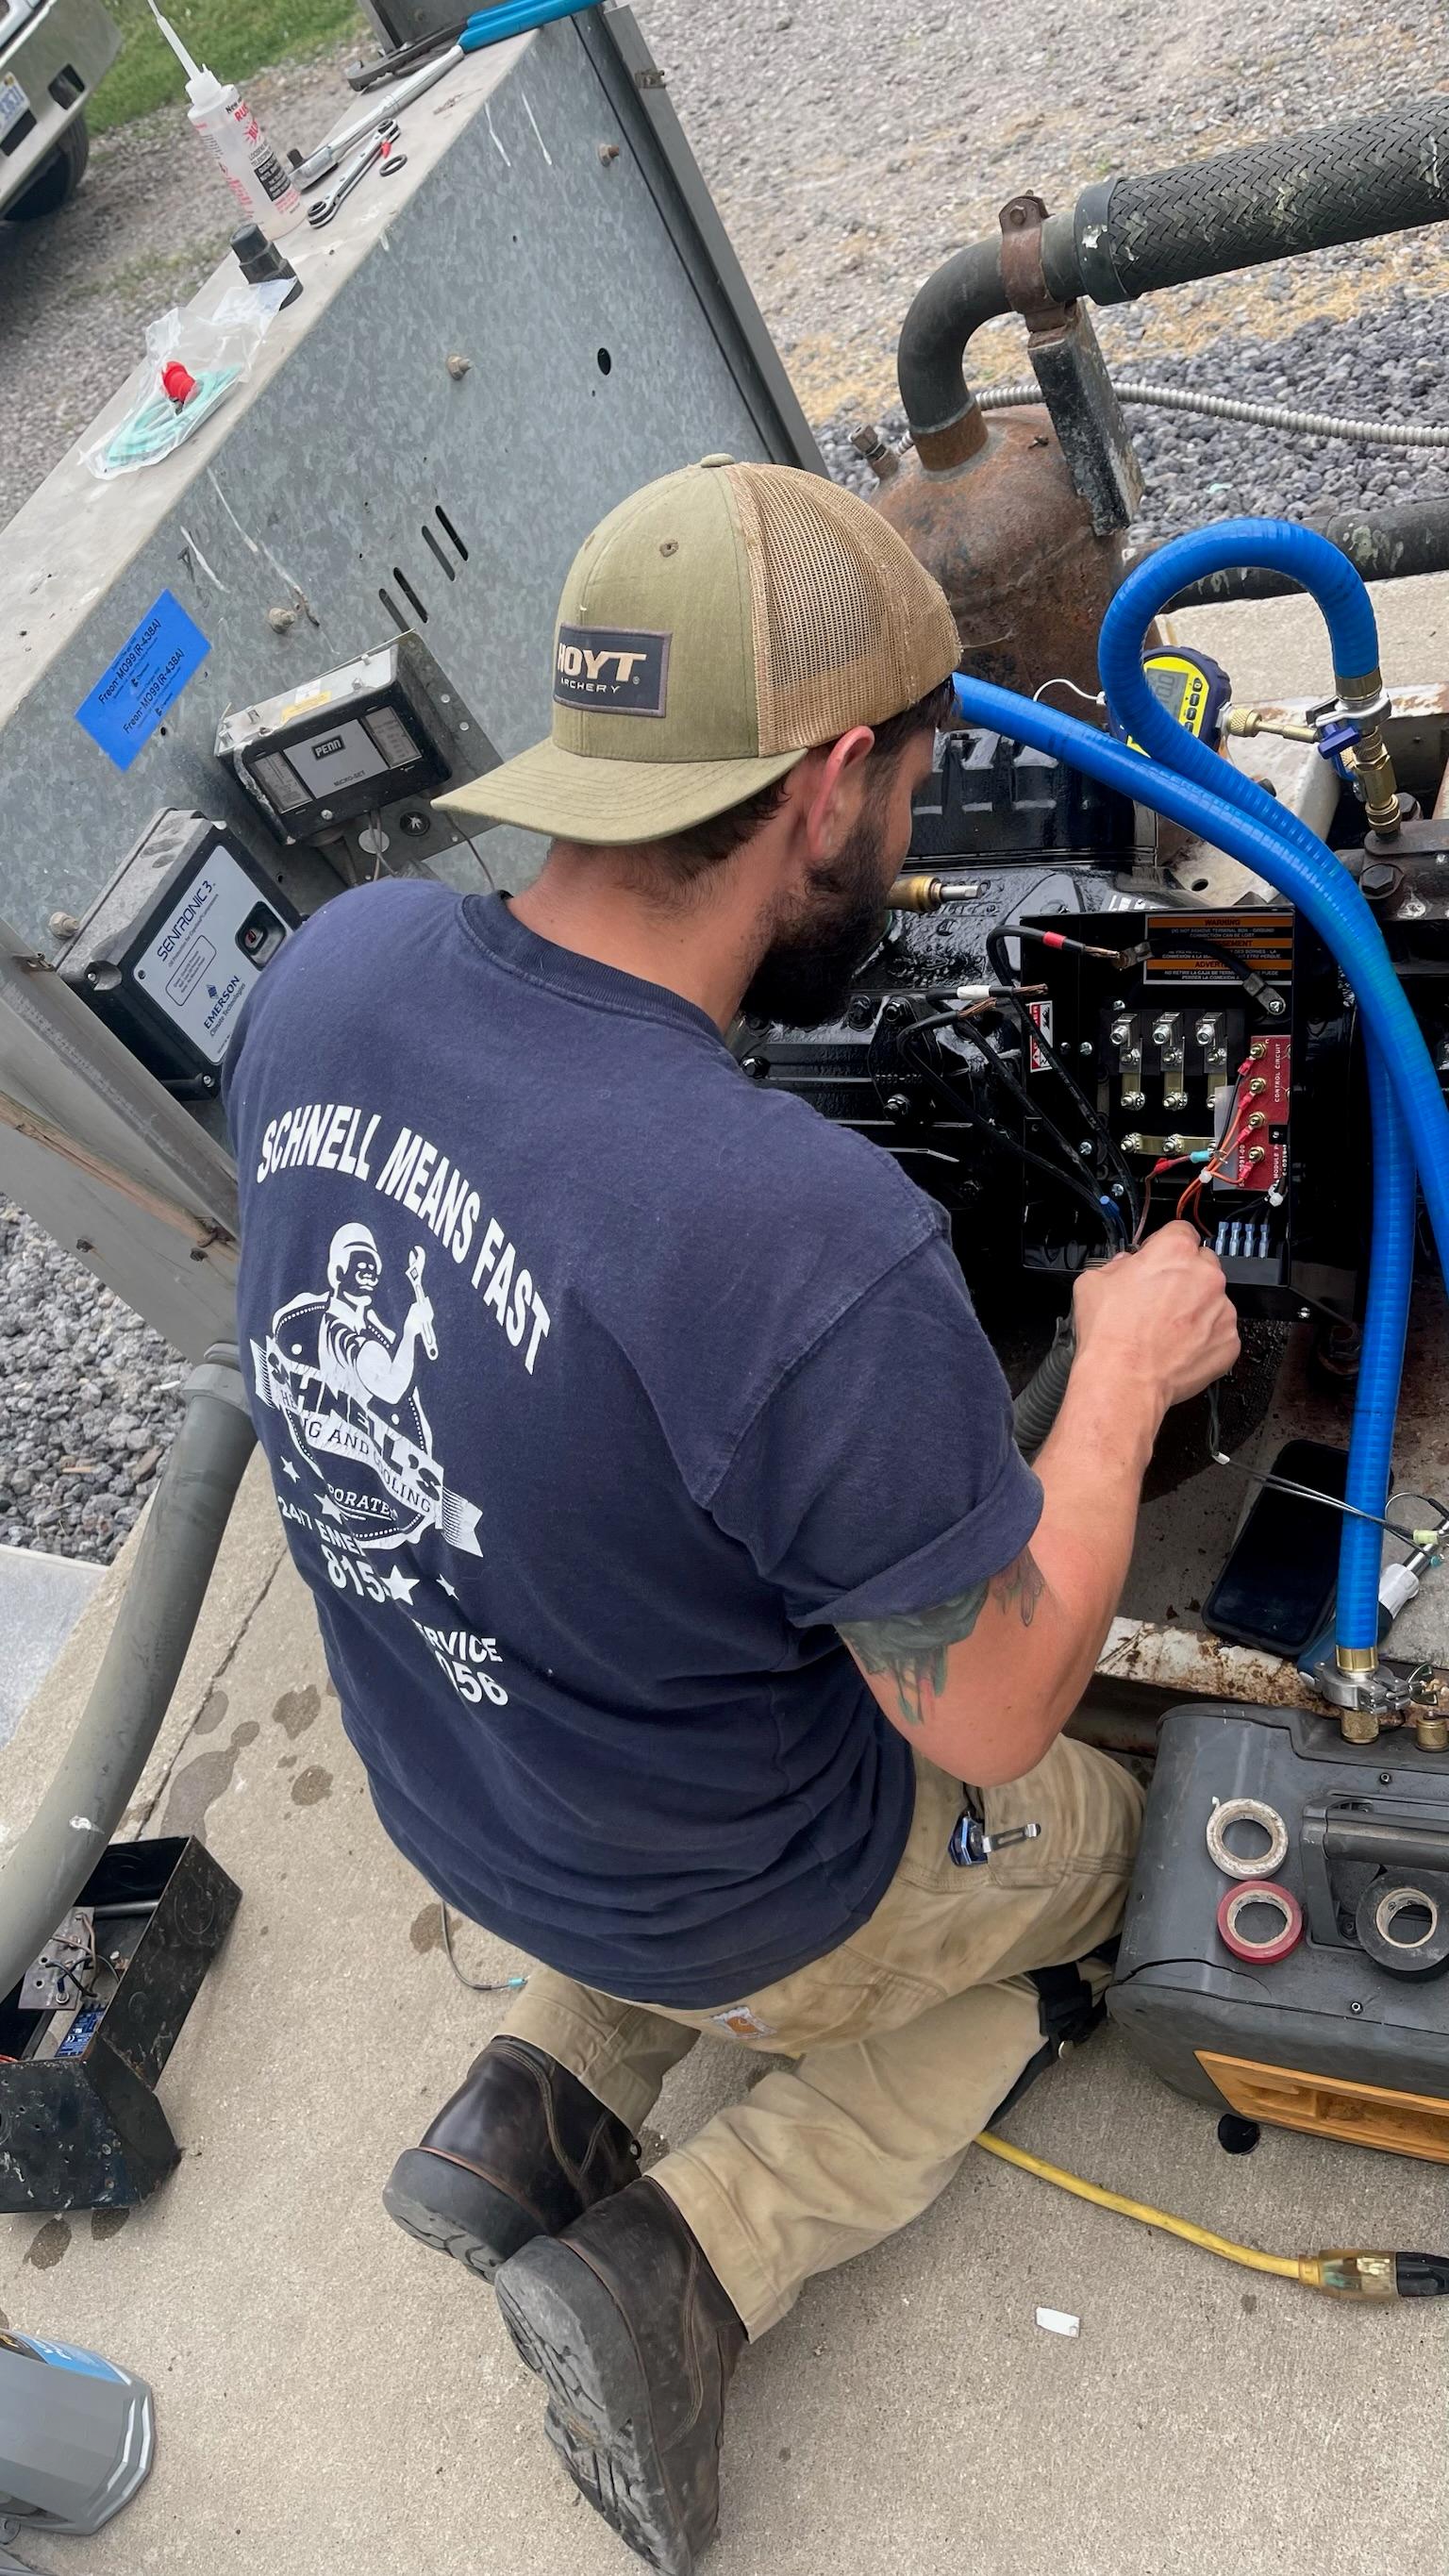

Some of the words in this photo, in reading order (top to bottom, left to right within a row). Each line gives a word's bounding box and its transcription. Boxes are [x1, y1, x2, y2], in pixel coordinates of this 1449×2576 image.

[136, 619, 162, 657] (R-438A)
[158, 648, 185, 687] (R-438A)
[315, 739, 342, 758] PENN
[157, 888, 208, 962] SENTRONIC
[202, 880, 212, 894] 3
[204, 976, 241, 1029] EMERSON
[209, 1015, 225, 1037] Climate
[257, 1104, 382, 1184] SCHNELL
[375, 1127, 481, 1263] MEANS
[471, 1217, 551, 1375] FAST
[327, 1428, 370, 1455] AND
[277, 1495, 313, 1531] 24/7
